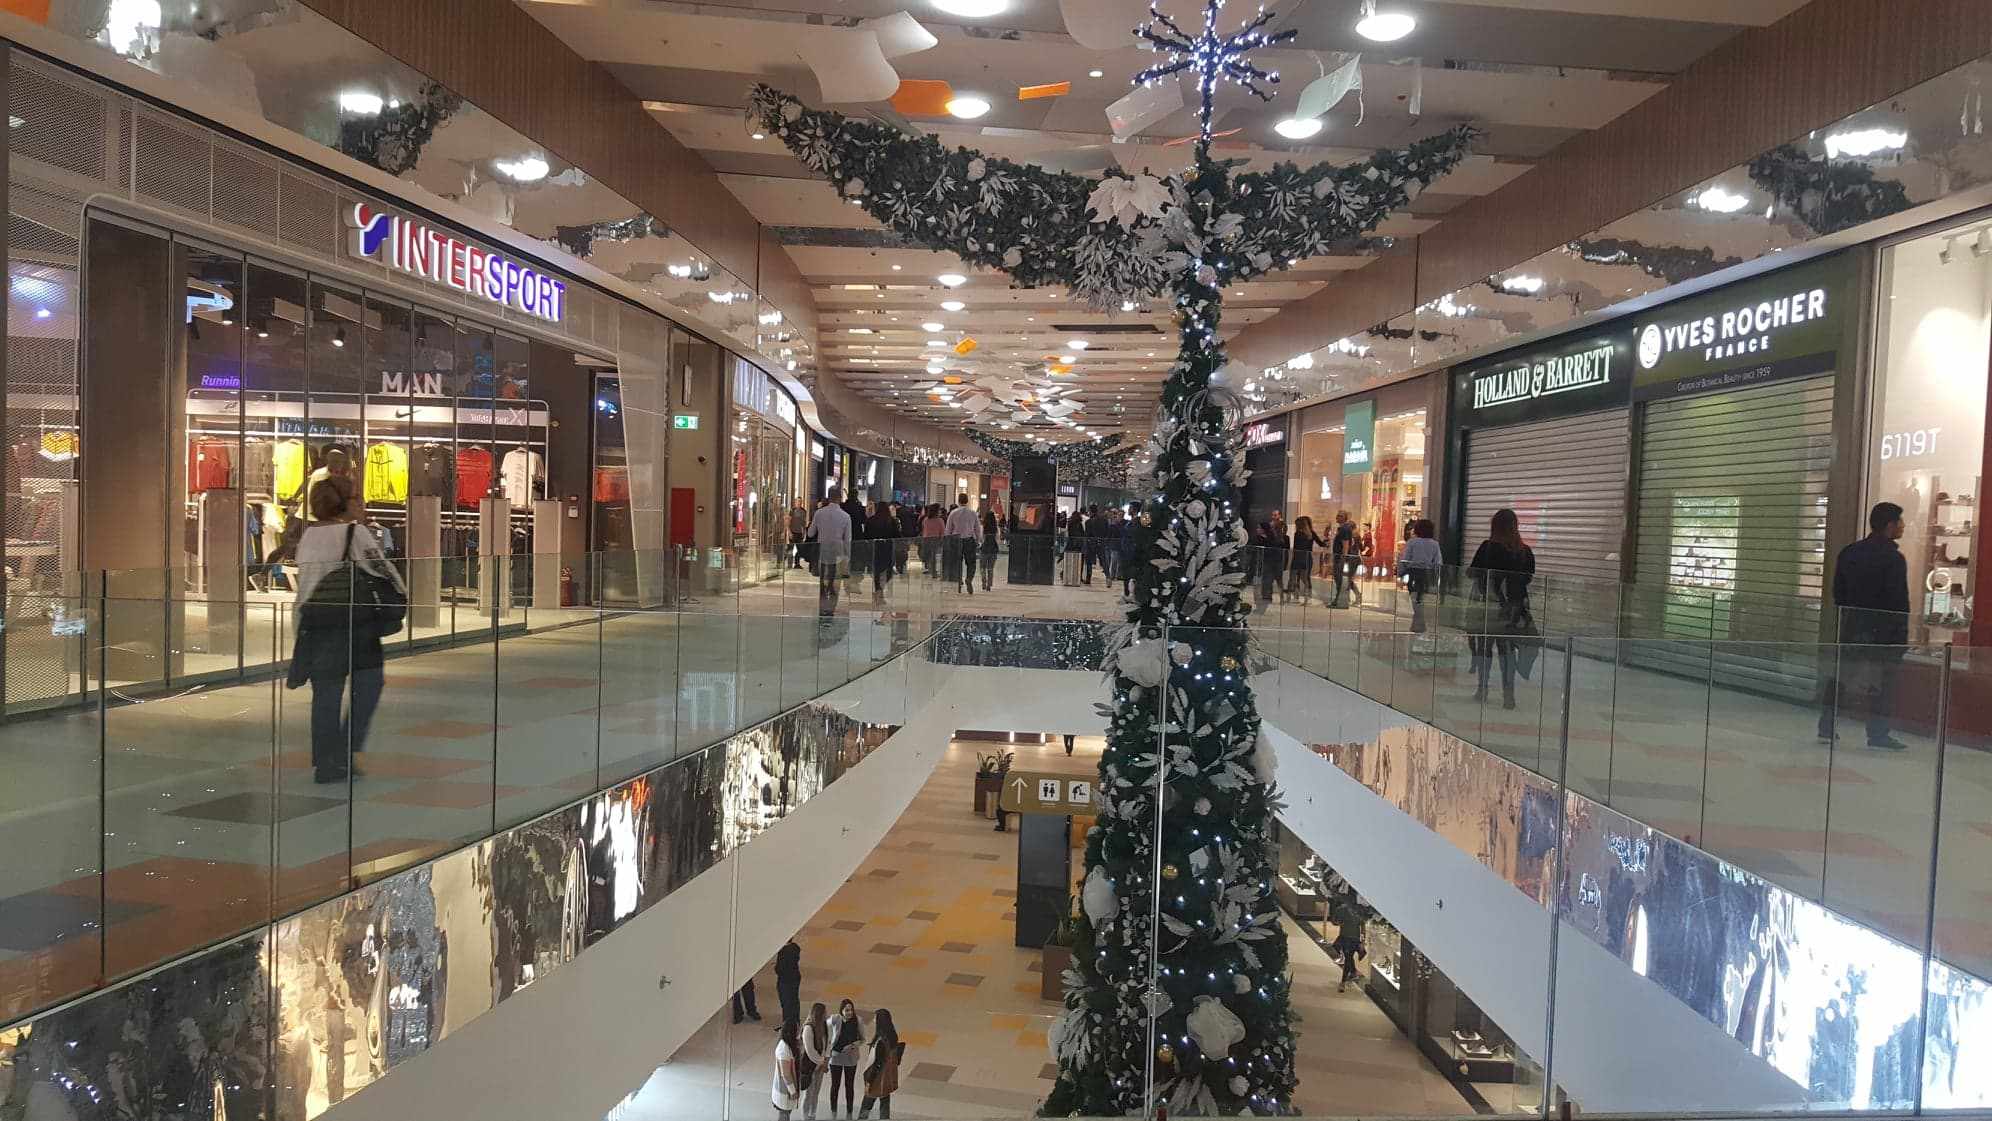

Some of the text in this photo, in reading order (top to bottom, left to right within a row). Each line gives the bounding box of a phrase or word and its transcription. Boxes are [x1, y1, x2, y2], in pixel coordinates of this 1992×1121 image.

[392, 215, 567, 322] INTERSPORT
[1664, 288, 1826, 352] YVES ROCHER
[1704, 335, 1770, 361] FRANCE
[200, 374, 242, 388] Runnin
[380, 370, 444, 396] MAN
[1473, 345, 1614, 409] HOLLAND & BARRETT
